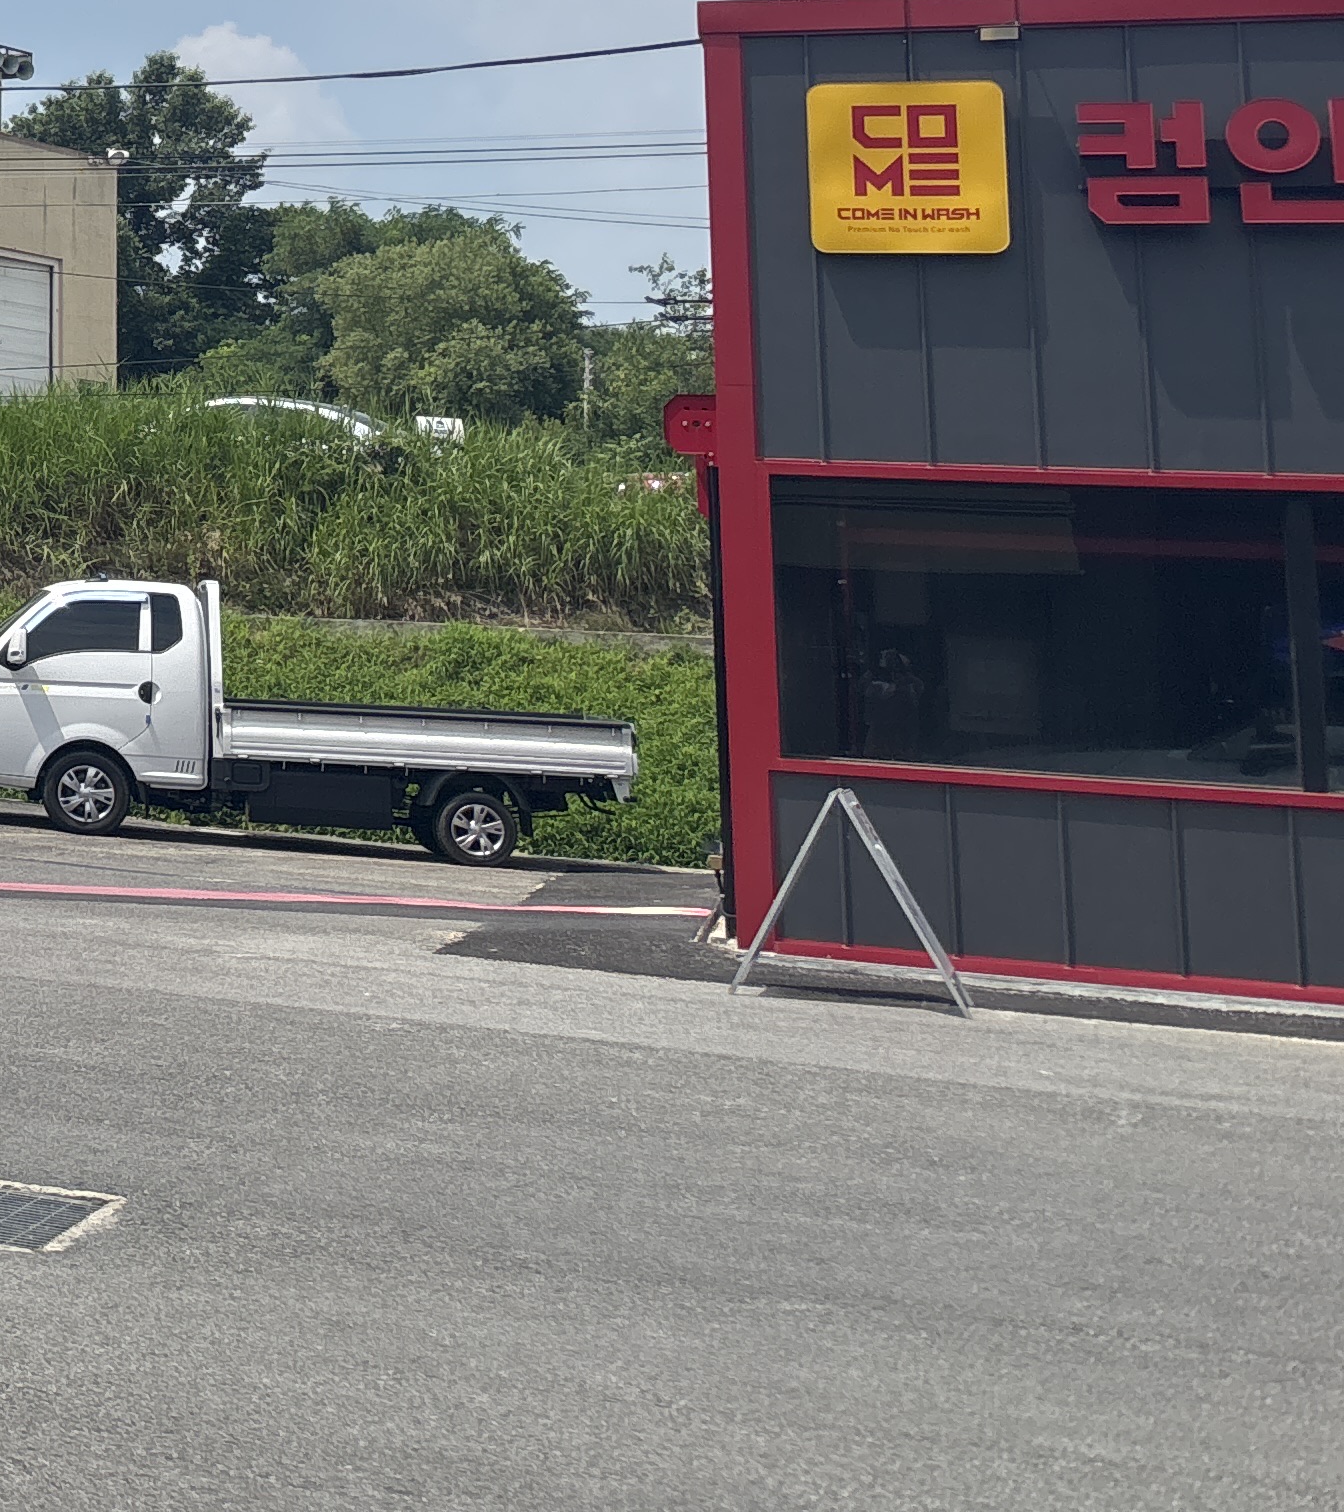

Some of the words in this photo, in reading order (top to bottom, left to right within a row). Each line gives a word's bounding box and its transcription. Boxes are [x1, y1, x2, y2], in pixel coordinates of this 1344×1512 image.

[837, 208, 895, 220] COME
[898, 208, 918, 220] IN
[921, 208, 981, 221] WASH
